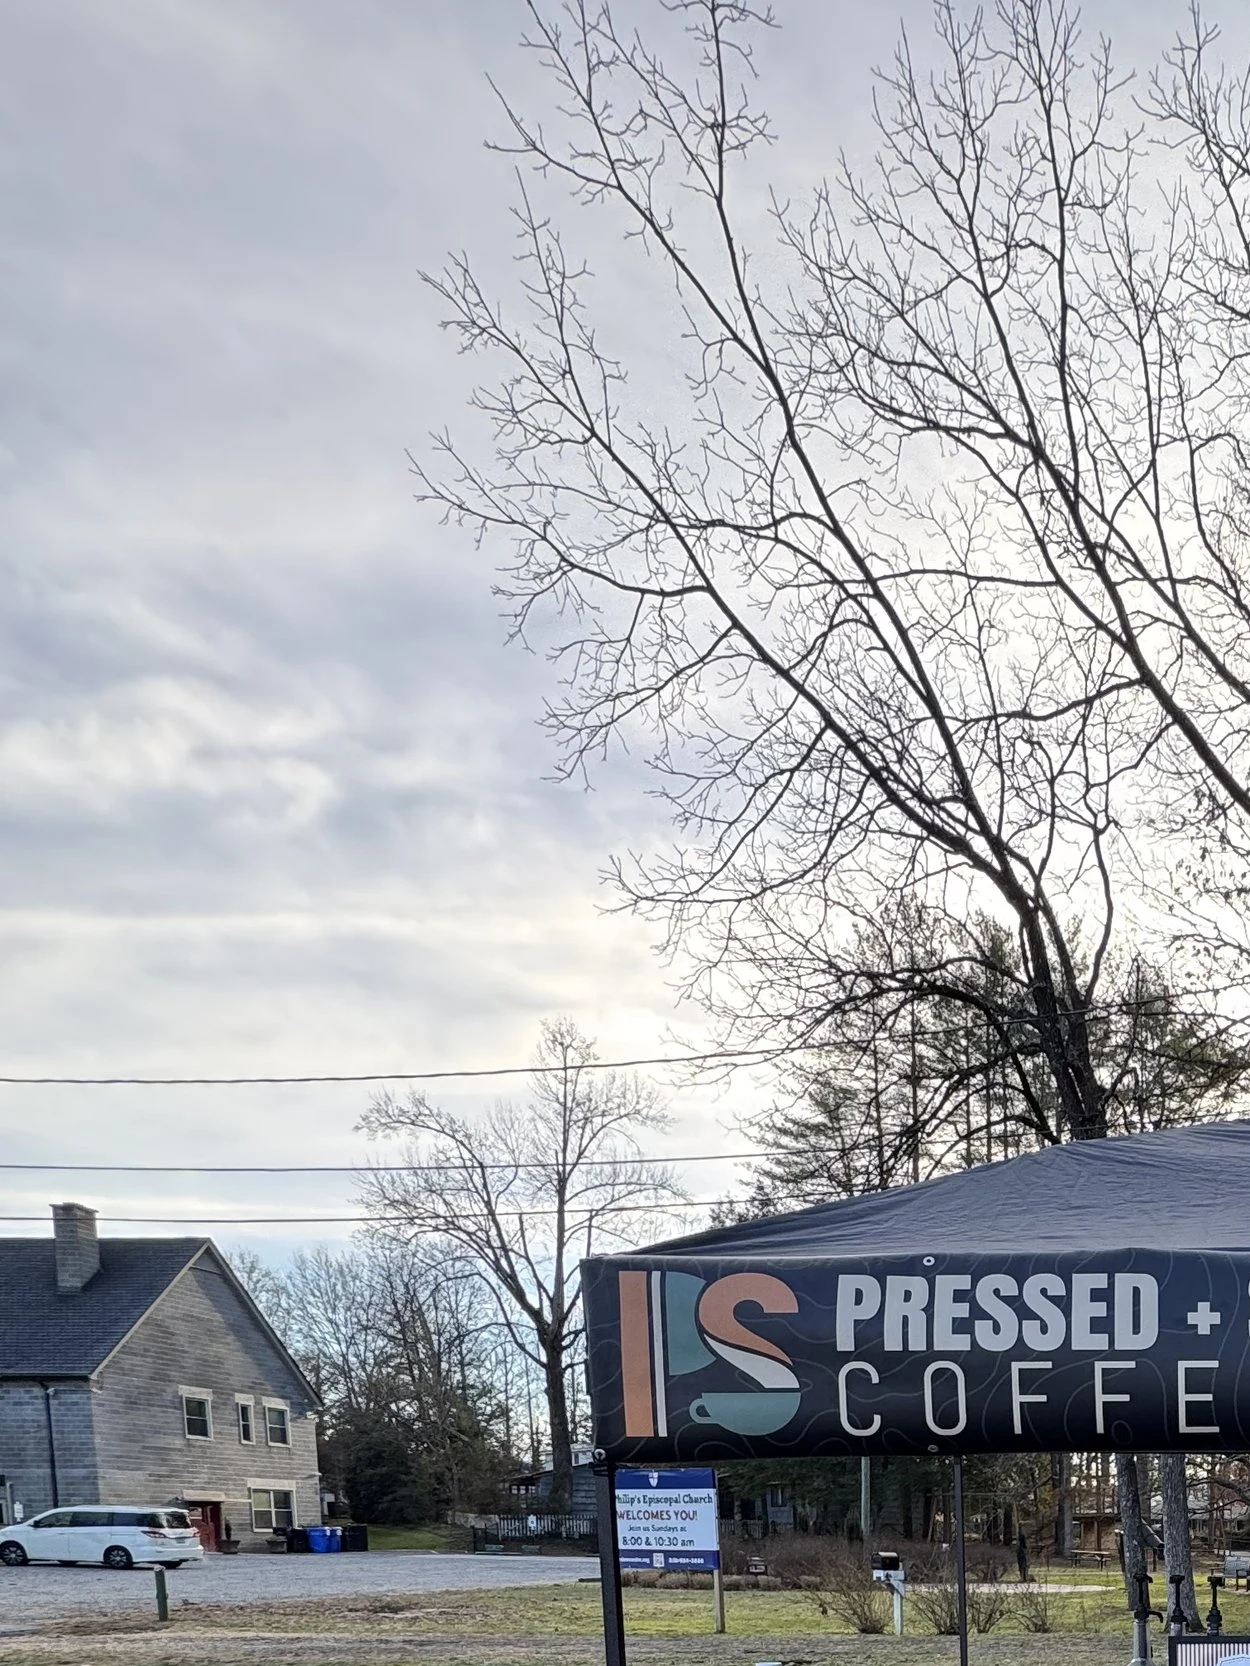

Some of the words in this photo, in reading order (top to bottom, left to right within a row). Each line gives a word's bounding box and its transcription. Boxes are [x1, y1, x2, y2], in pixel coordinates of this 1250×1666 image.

[836, 1271, 1158, 1352] PRESSED
[615, 1494, 641, 1506] hilip's
[643, 1494, 681, 1506] Episcopal
[682, 1493, 713, 1504] Church
[617, 1510, 671, 1521] WELCOMES
[675, 1510, 697, 1521] YOU!
[651, 1525, 678, 1533] Sundays
[622, 1536, 642, 1546] 8:00
[645, 1537, 652, 1546] &
[654, 1536, 678, 1546] 10:30
